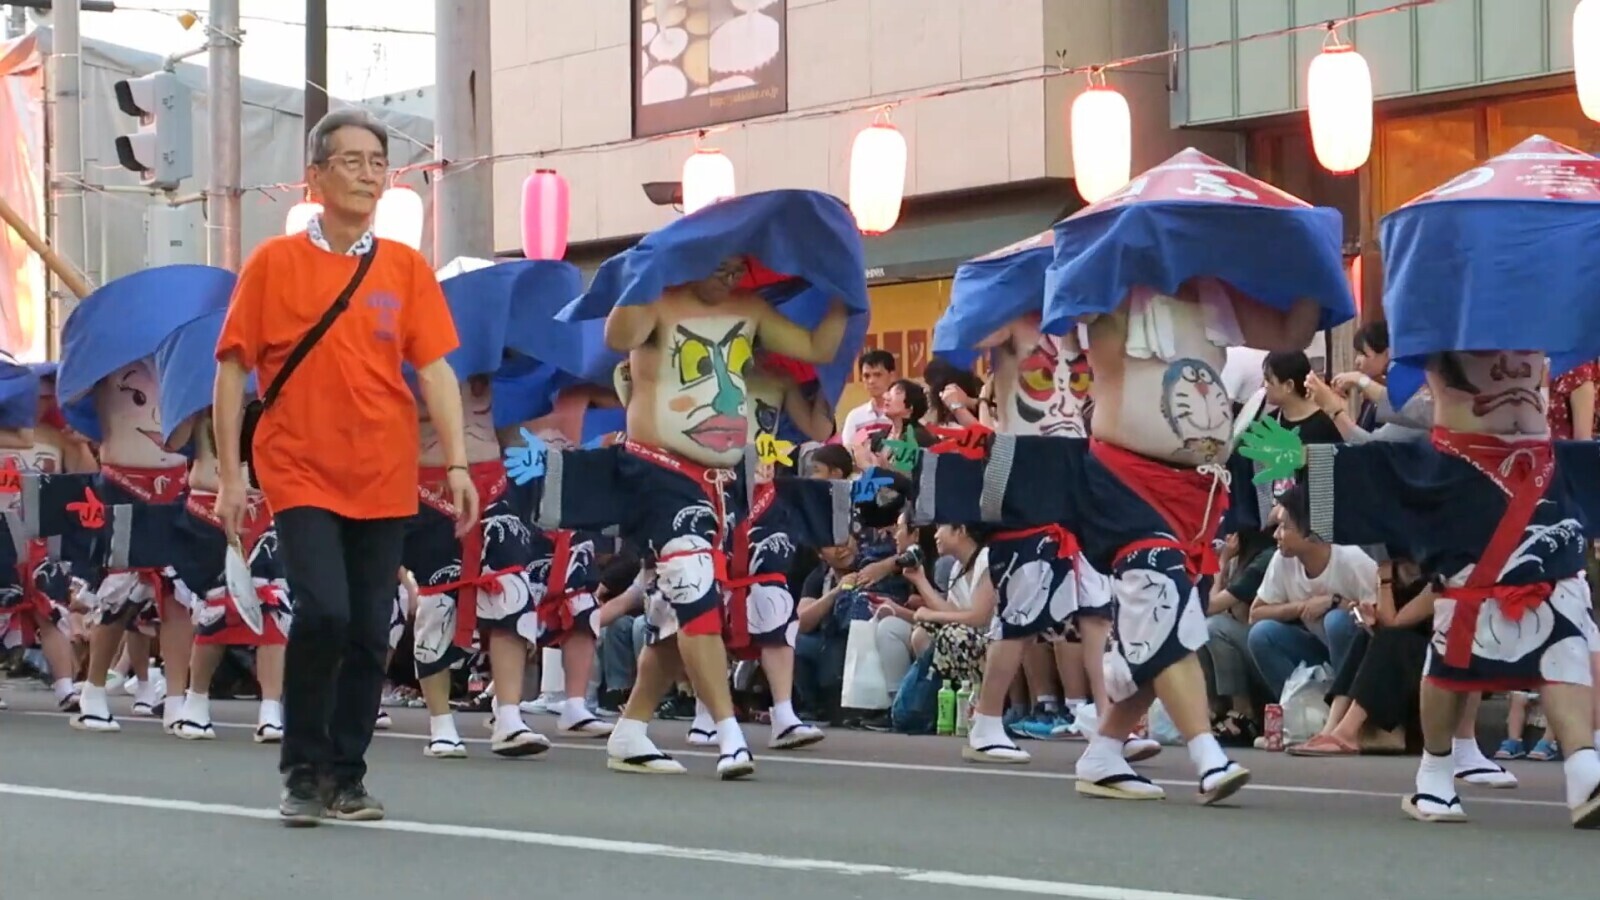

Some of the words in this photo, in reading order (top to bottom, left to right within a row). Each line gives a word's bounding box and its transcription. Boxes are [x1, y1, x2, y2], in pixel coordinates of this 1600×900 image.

[957, 430, 988, 449] JA
[758, 441, 777, 457] JA
[522, 450, 546, 467] JA
[2, 473, 20, 489] JA
[850, 480, 875, 495] JA
[82, 507, 104, 521] JA
